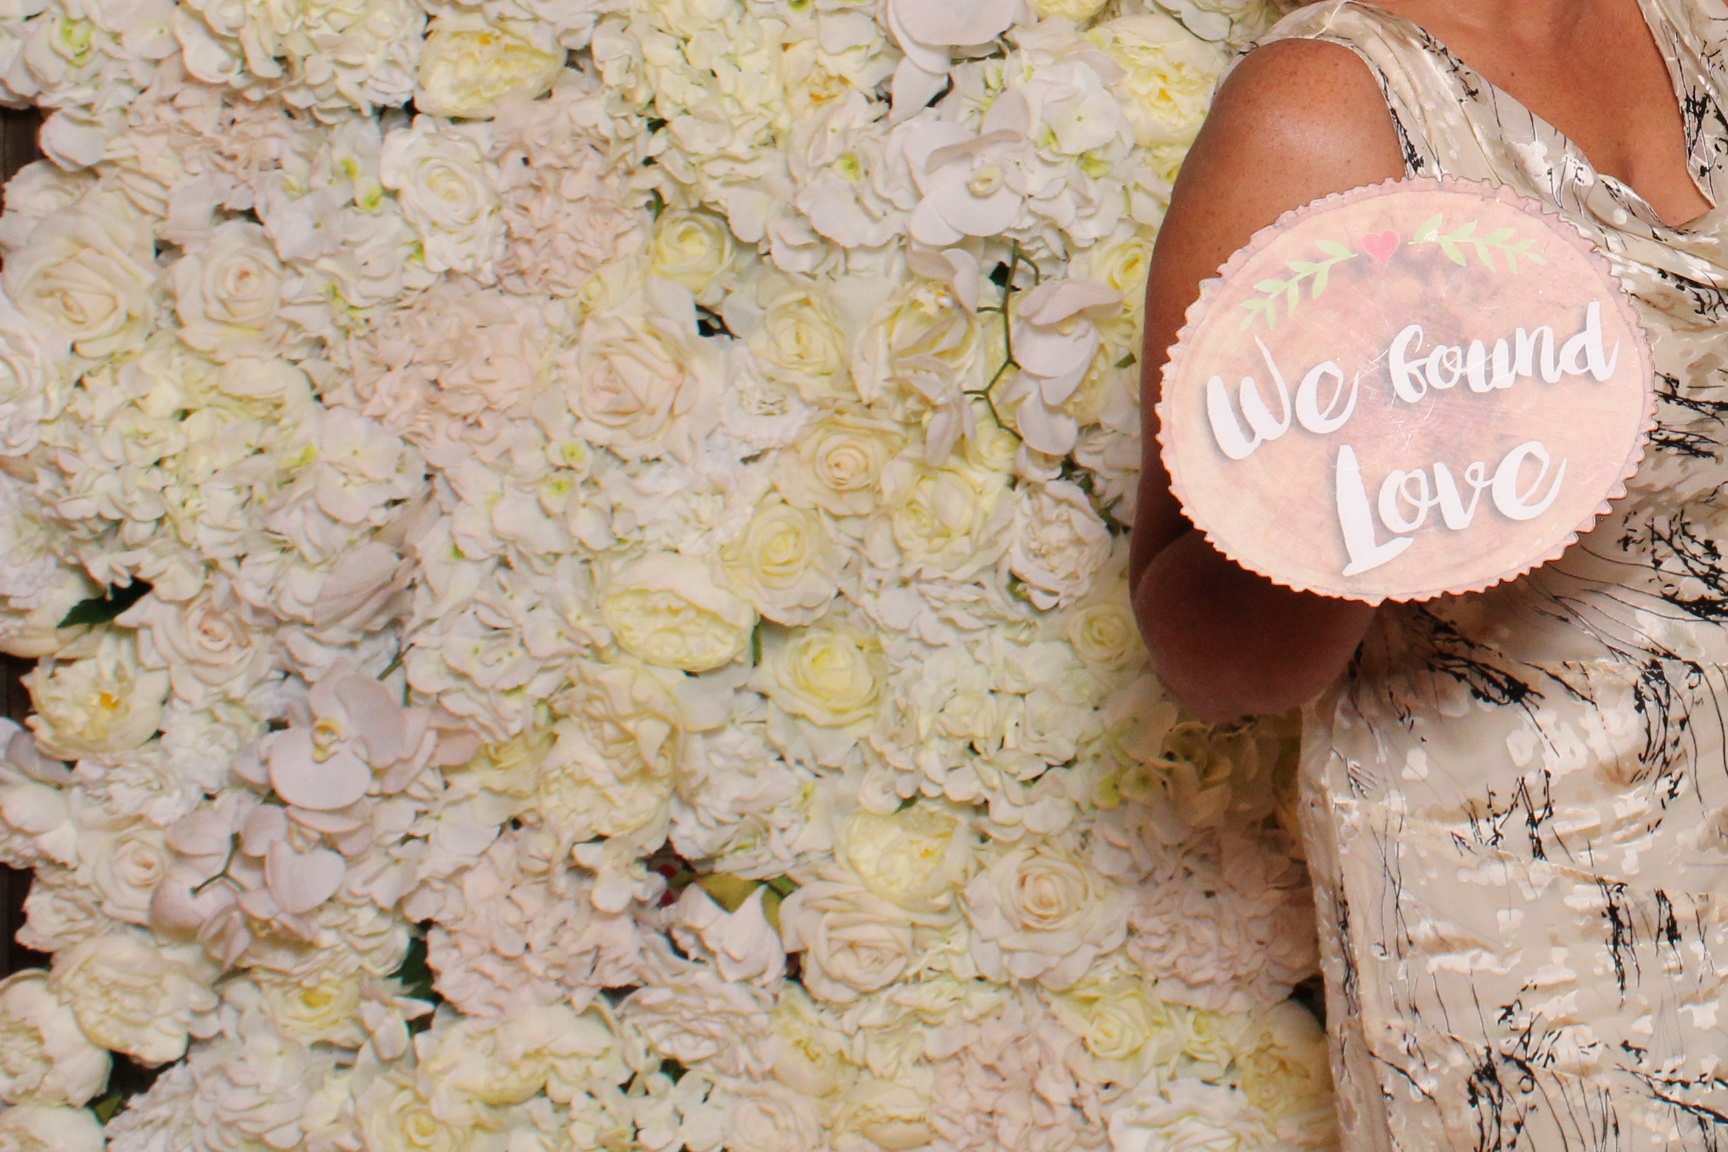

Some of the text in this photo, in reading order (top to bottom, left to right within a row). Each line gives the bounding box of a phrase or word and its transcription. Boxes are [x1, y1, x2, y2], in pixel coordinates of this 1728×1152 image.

[1206, 300, 1621, 460] We found
[1335, 440, 1569, 577] Love
